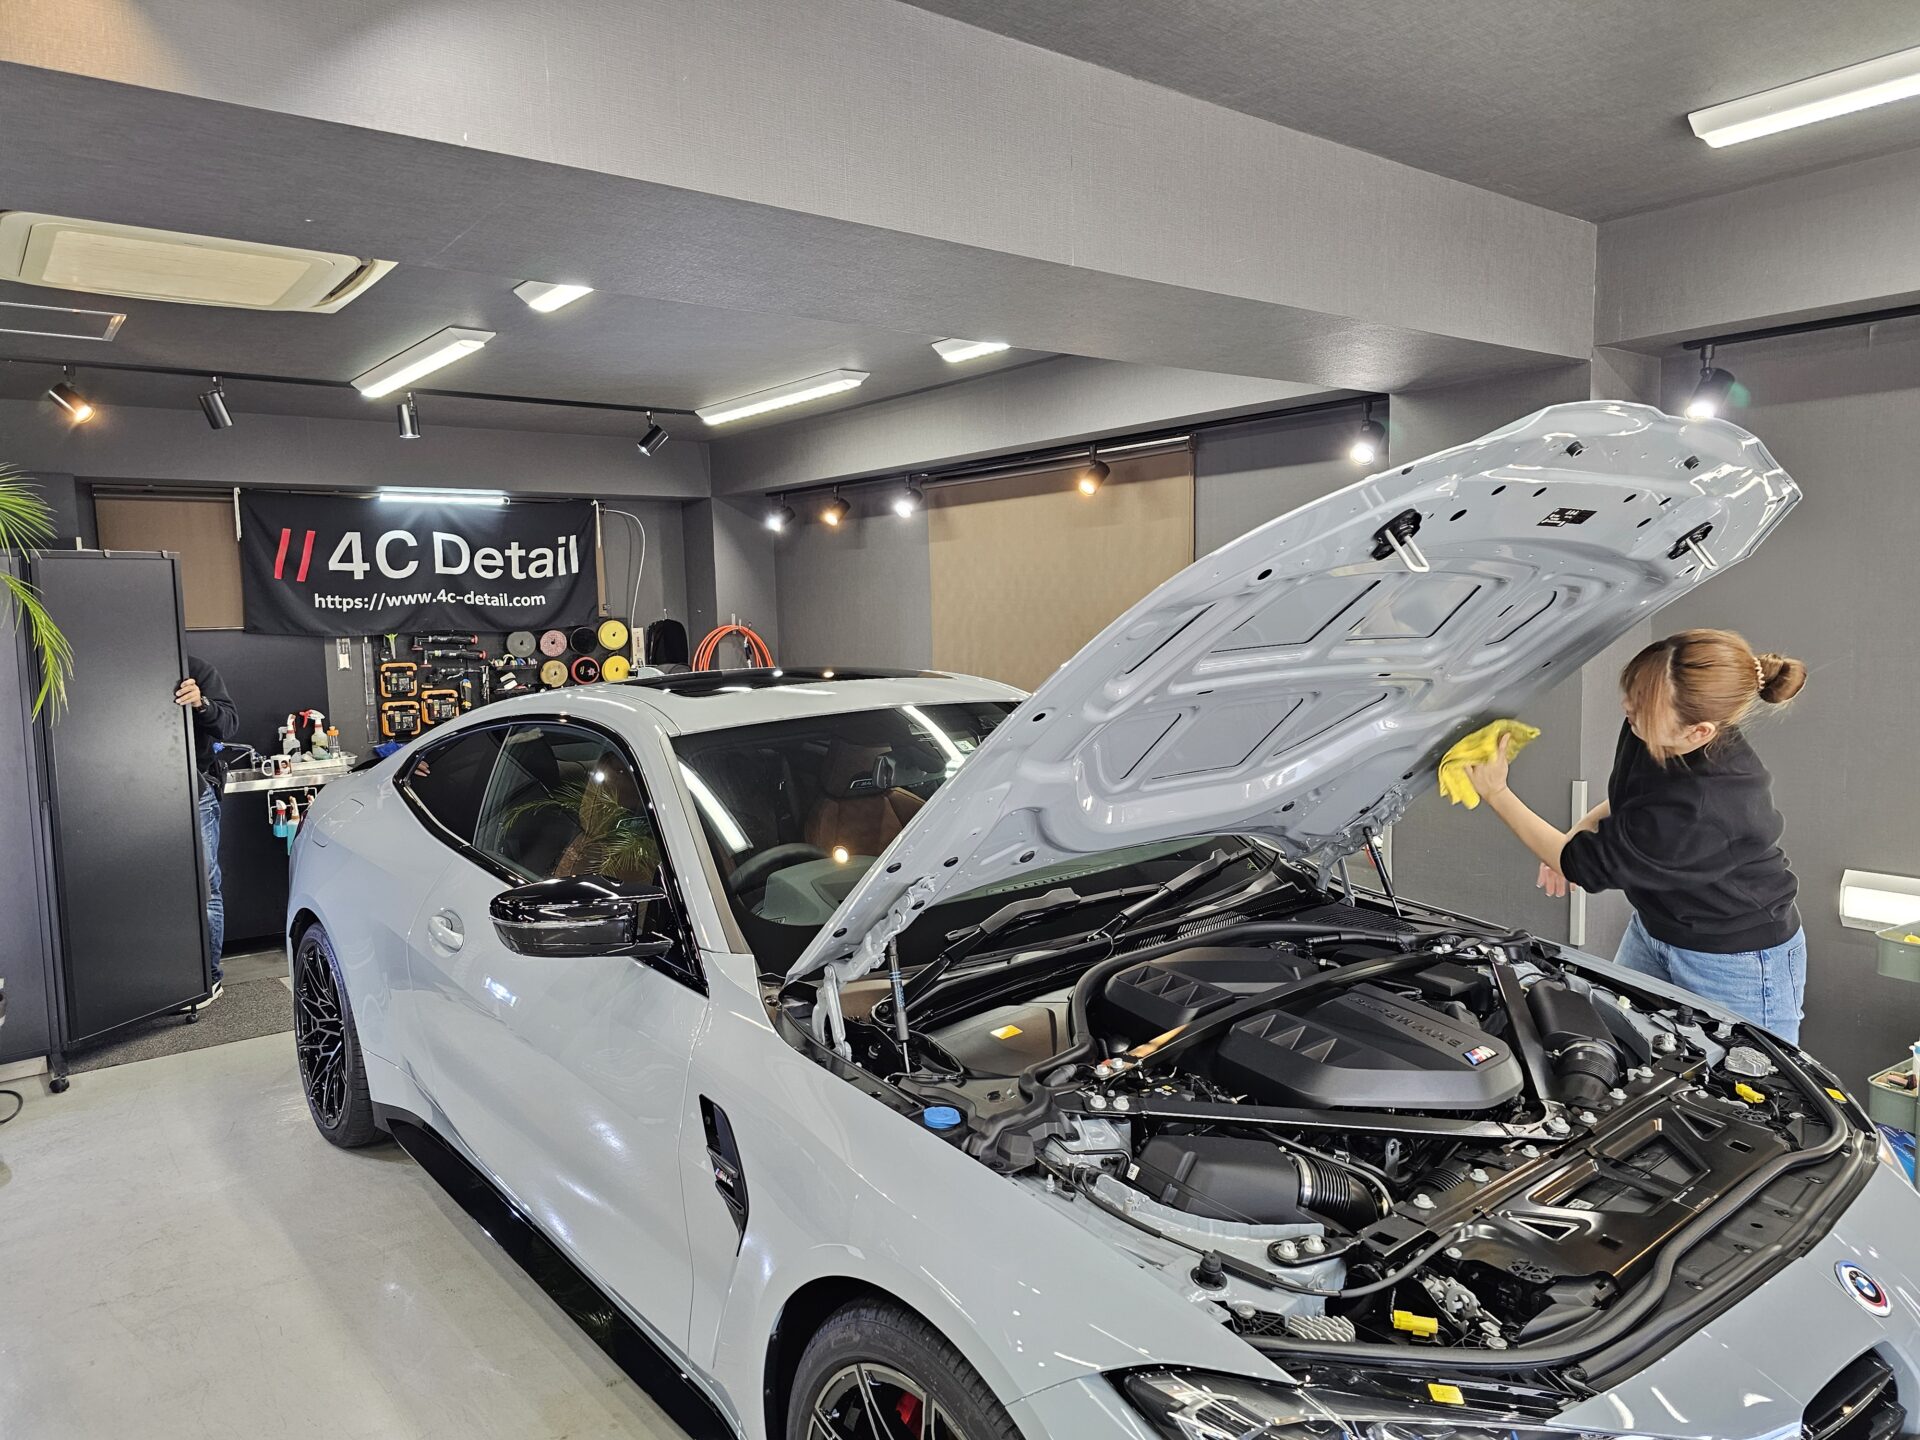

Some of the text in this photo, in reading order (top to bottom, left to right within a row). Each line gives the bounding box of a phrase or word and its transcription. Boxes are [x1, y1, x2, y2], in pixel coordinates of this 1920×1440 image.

[328, 530, 580, 580] 4C Detail
[314, 588, 546, 612] https://www.4c-detail.com
